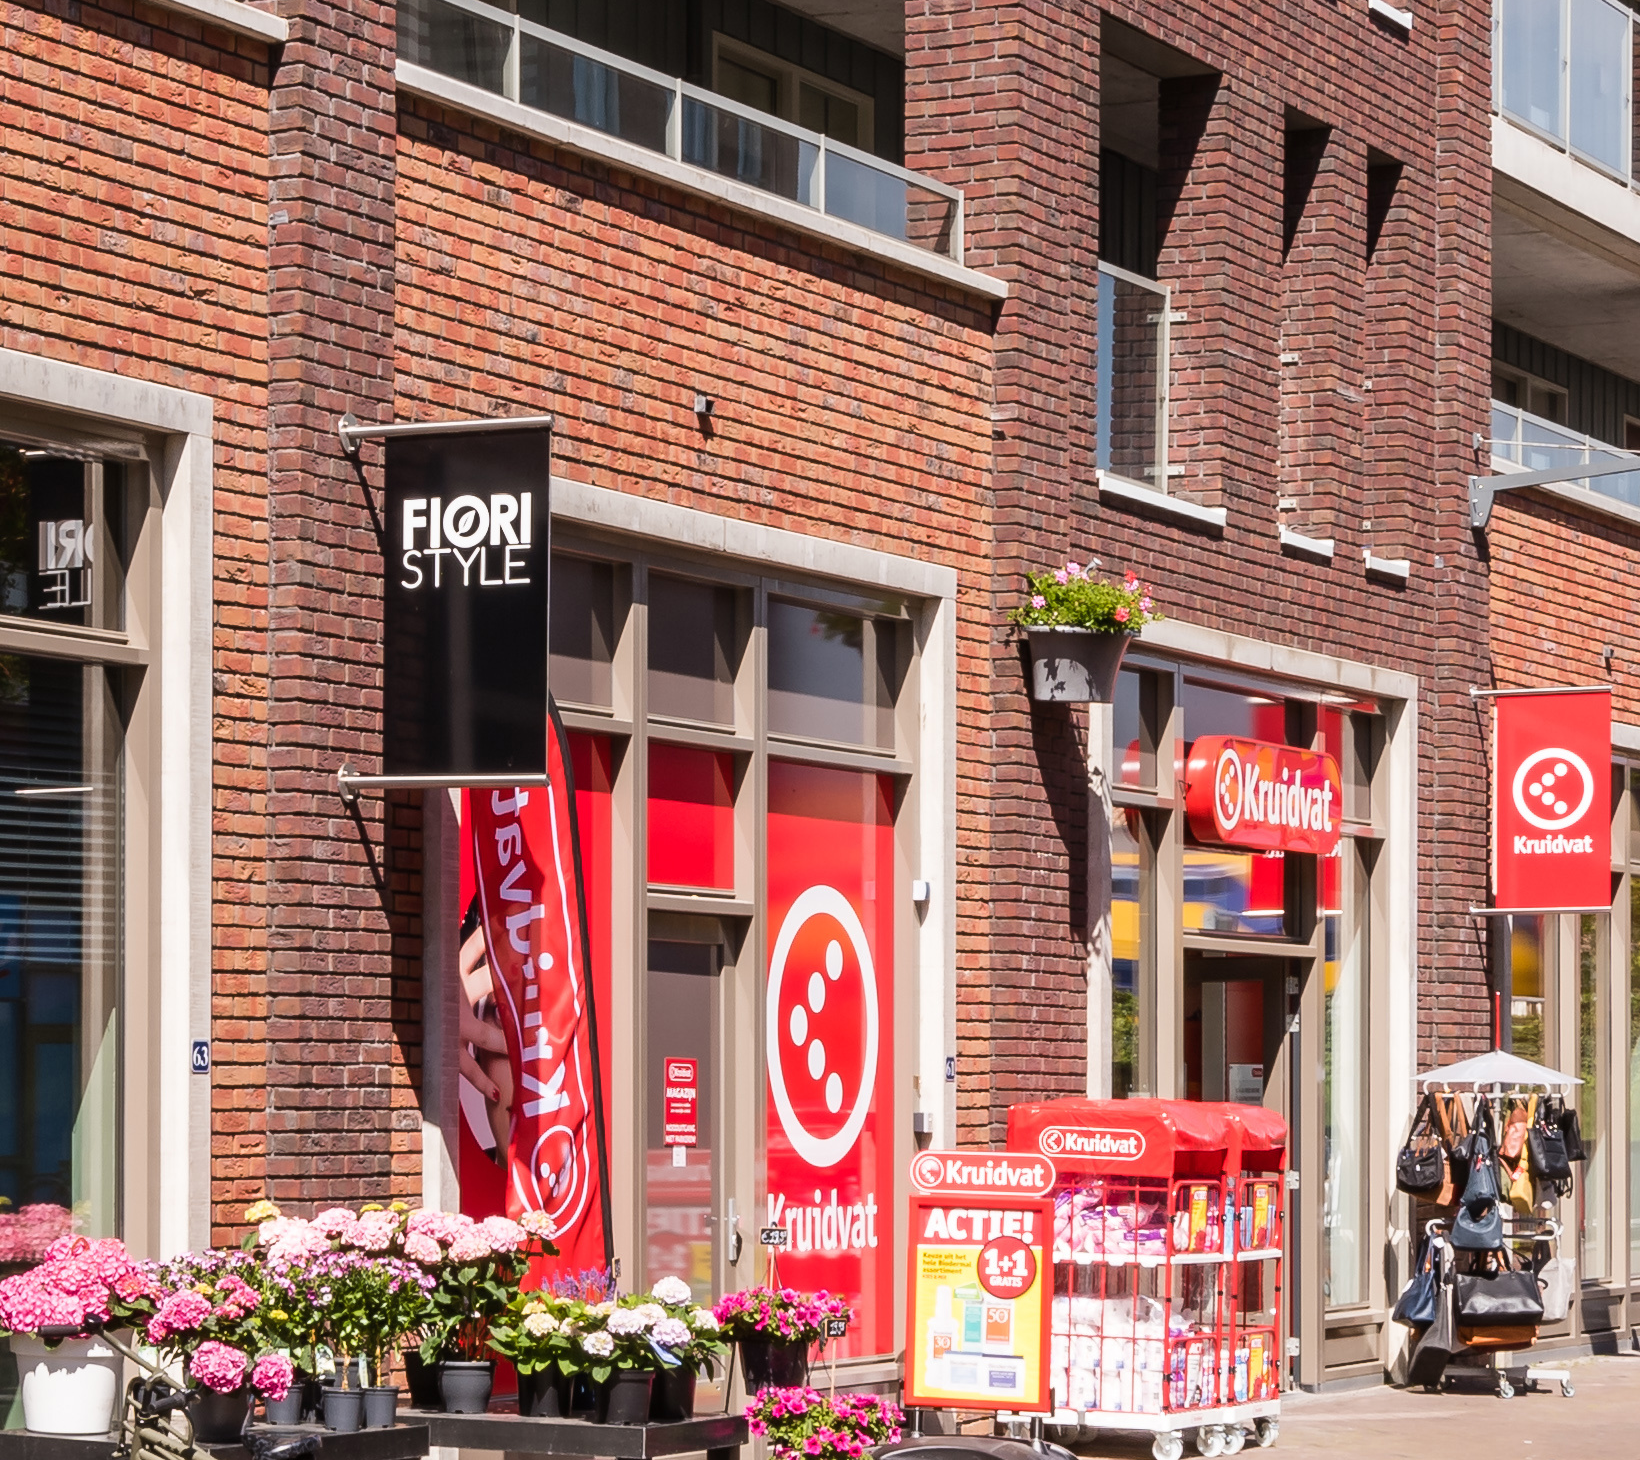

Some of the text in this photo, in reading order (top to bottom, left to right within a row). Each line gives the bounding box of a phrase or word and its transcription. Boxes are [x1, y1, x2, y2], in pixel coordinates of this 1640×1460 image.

[403, 492, 531, 550] FIORI
[401, 544, 531, 589] STYLE
[1244, 763, 1332, 832] Kruidvat
[1514, 834, 1593, 854] Kruidvat
[193, 1046, 208, 1066] 63
[1065, 1133, 1137, 1154] Kruidvat
[946, 1160, 1044, 1187] Kruidvat
[768, 1188, 878, 1253] Kruidvat
[924, 1208, 1034, 1243] ACTIE!
[984, 1248, 1028, 1276] 1+1
[990, 1276, 1022, 1287] GRATIS
